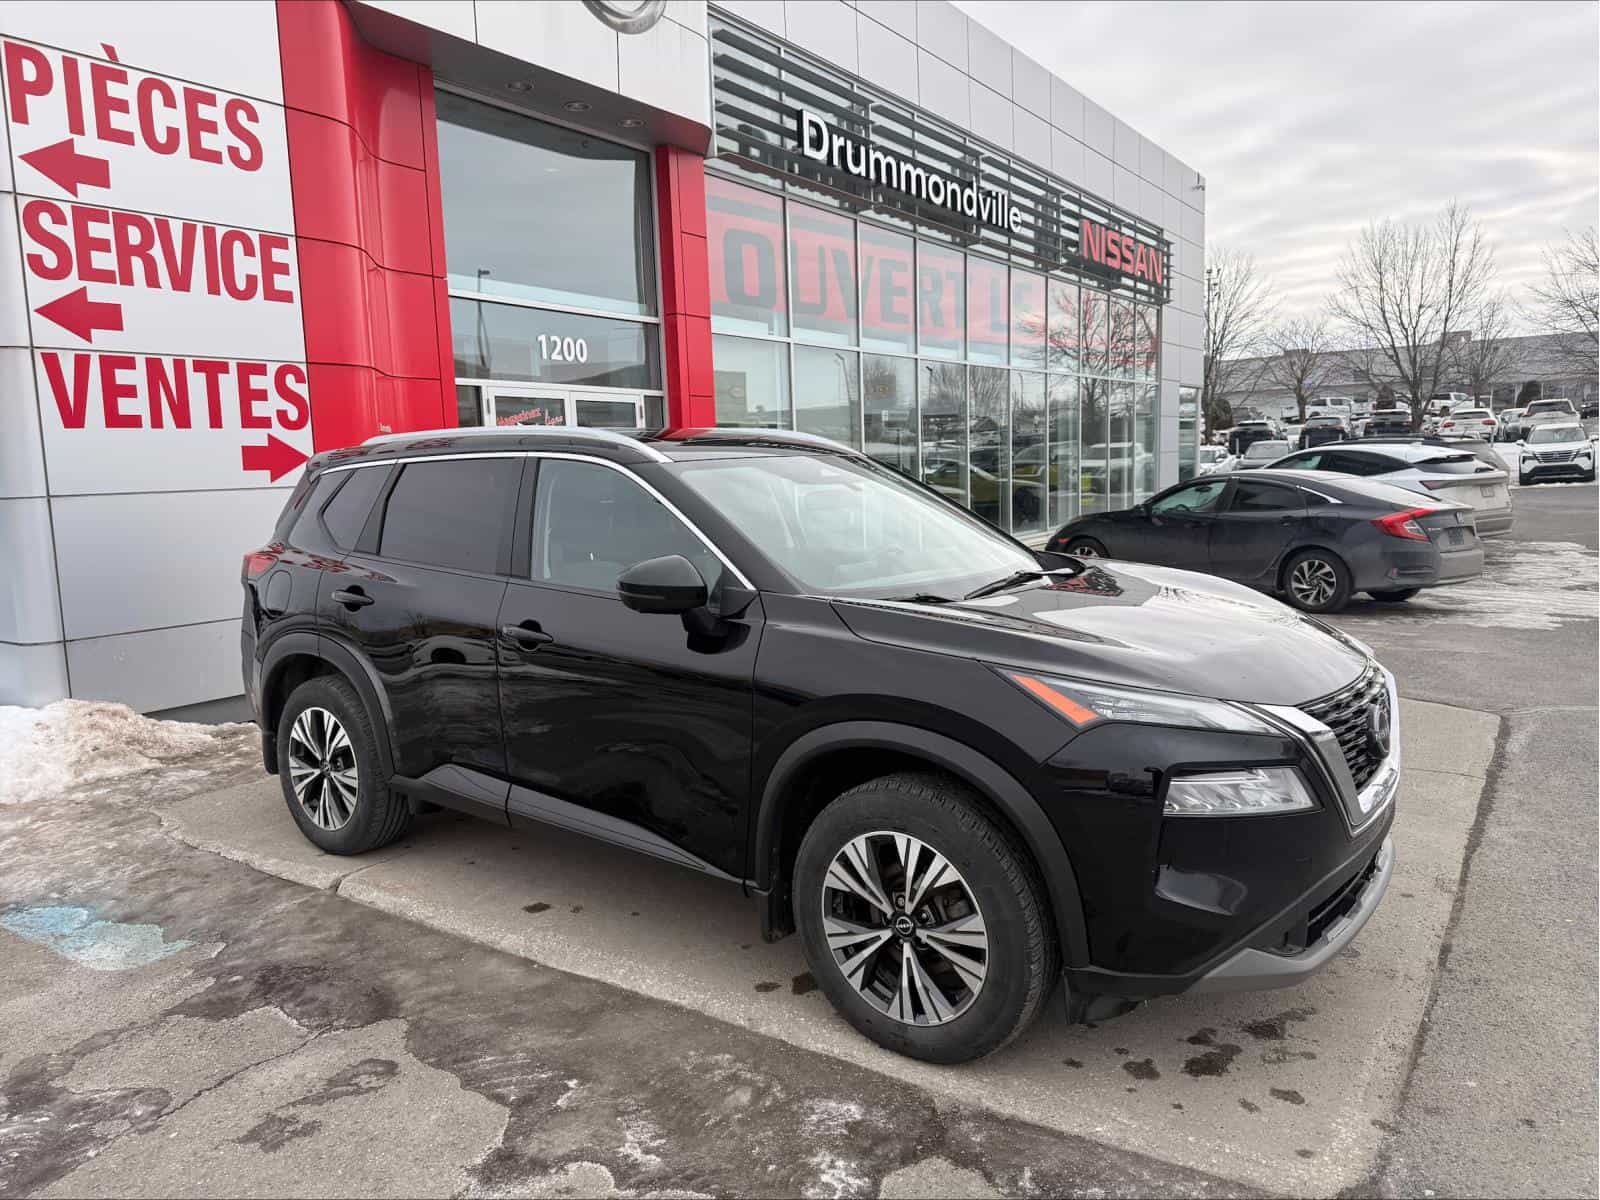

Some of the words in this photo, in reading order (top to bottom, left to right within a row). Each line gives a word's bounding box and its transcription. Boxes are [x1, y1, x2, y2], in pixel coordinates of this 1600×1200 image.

[3, 41, 263, 172] PIÈCES
[802, 109, 1022, 233] Drummondville
[22, 200, 294, 303] SERVICE
[723, 228, 970, 328] OUVERT
[1083, 219, 1163, 284] NISSAN
[41, 351, 310, 430] VENTES
[537, 334, 588, 363] 1200
